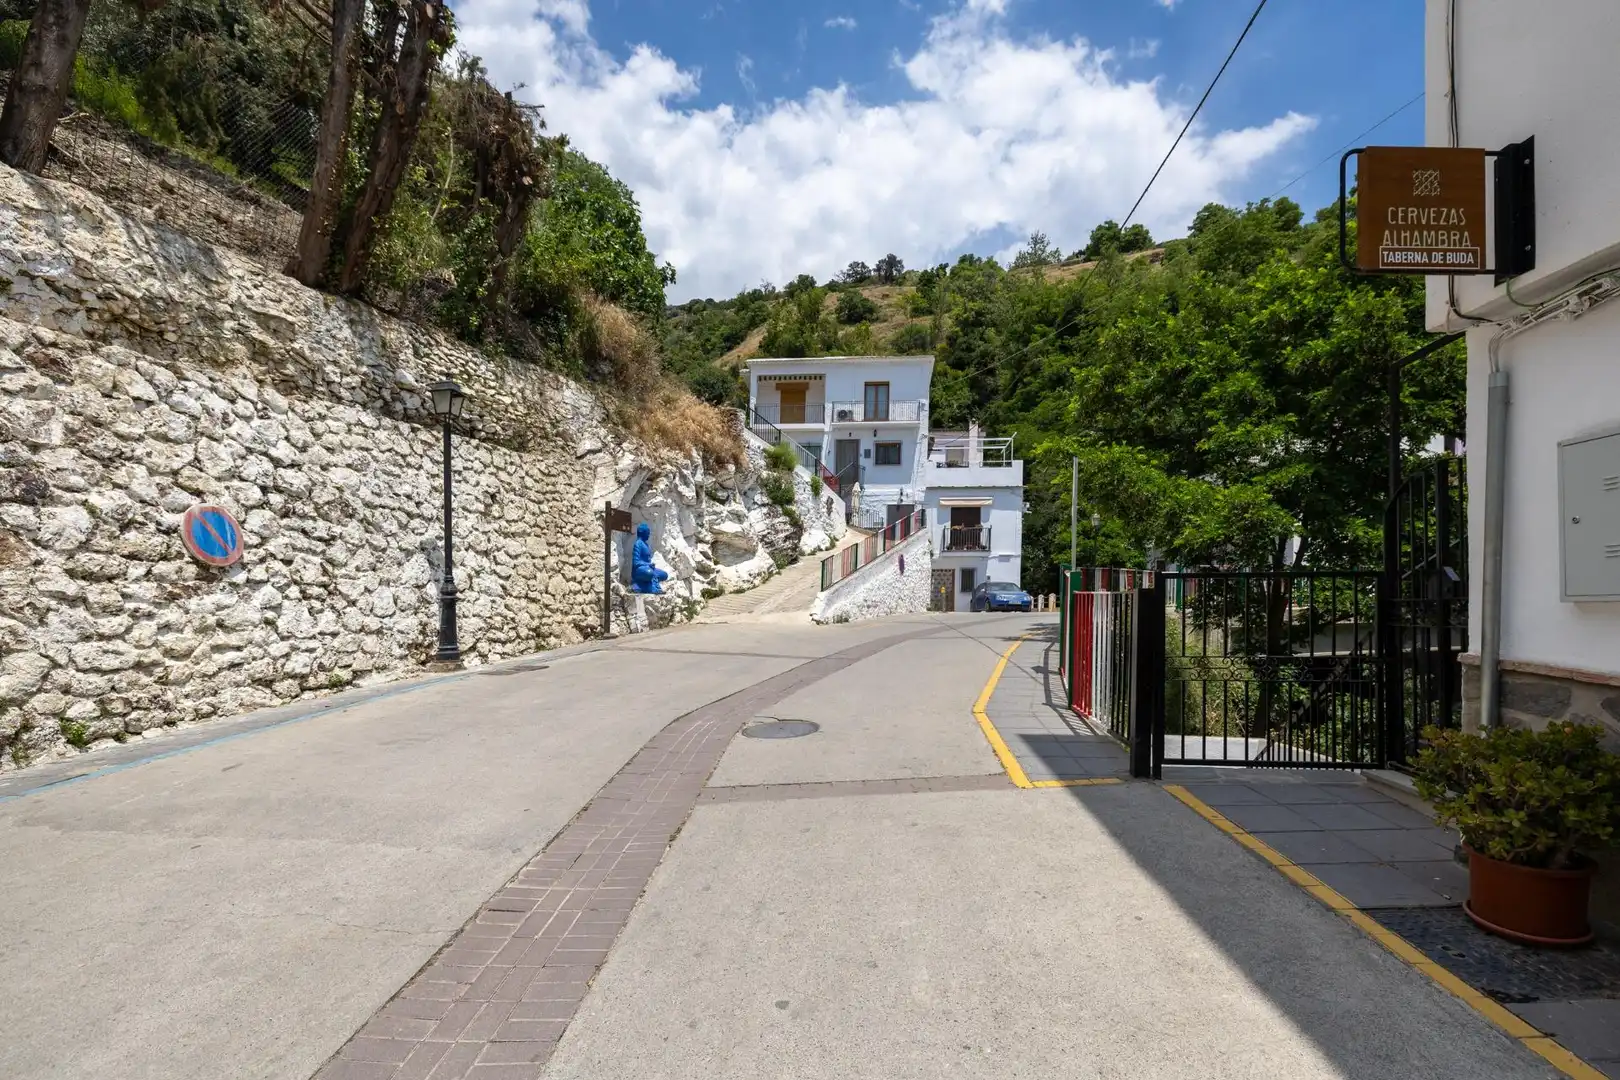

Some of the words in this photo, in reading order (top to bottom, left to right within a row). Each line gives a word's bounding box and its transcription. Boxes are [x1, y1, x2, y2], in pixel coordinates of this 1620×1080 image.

[1388, 207, 1466, 225] CERVEZAS
[1382, 229, 1471, 247] ALHAMBRA
[1382, 251, 1428, 263] TABERNA
[1431, 251, 1444, 263] DE
[1446, 251, 1474, 264] BUDA
